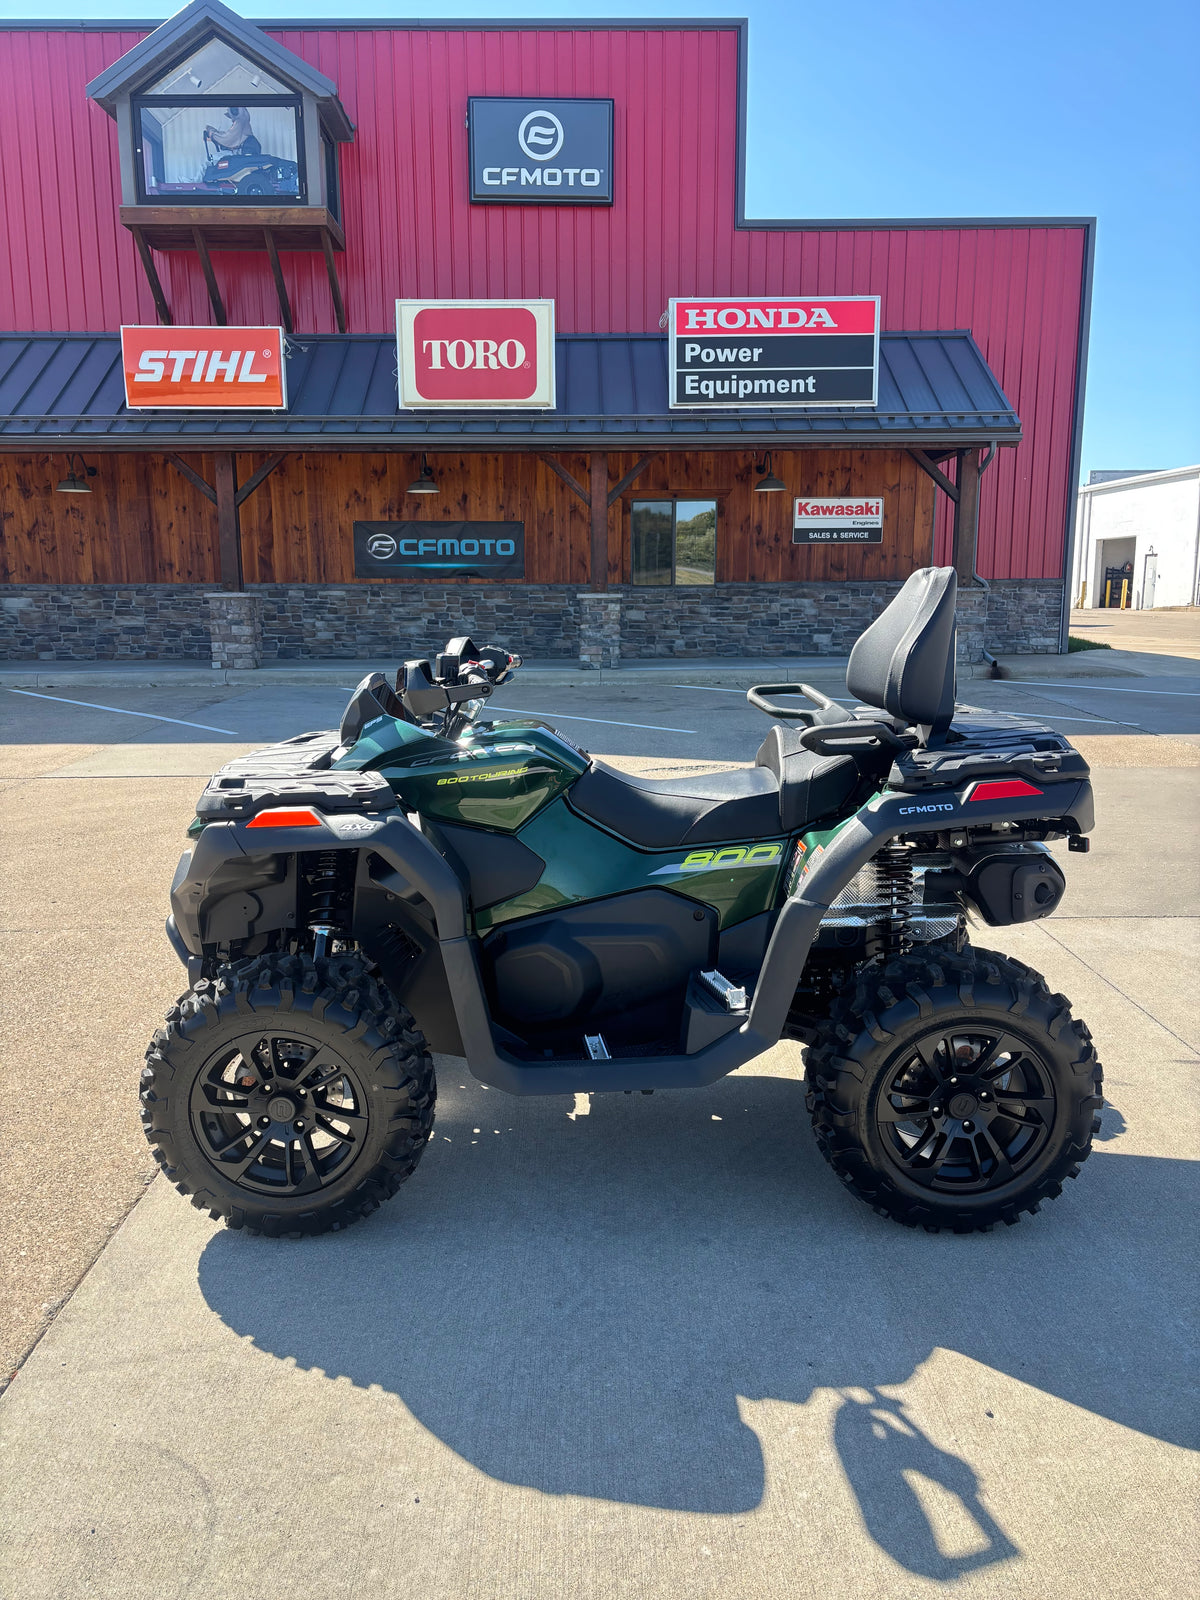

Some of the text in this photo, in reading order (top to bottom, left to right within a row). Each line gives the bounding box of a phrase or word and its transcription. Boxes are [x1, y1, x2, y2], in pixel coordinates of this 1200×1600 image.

[483, 168, 600, 187] CFMOTO
[685, 308, 838, 329] HONDA
[423, 339, 526, 370] TORO
[685, 343, 763, 363] Power
[134, 350, 268, 383] STIHL
[685, 375, 816, 399] Equipment
[798, 502, 880, 516] Kawasaki
[400, 539, 515, 556] CFMOTO
[899, 803, 954, 815] CFMOTO
[679, 843, 783, 870] 800
